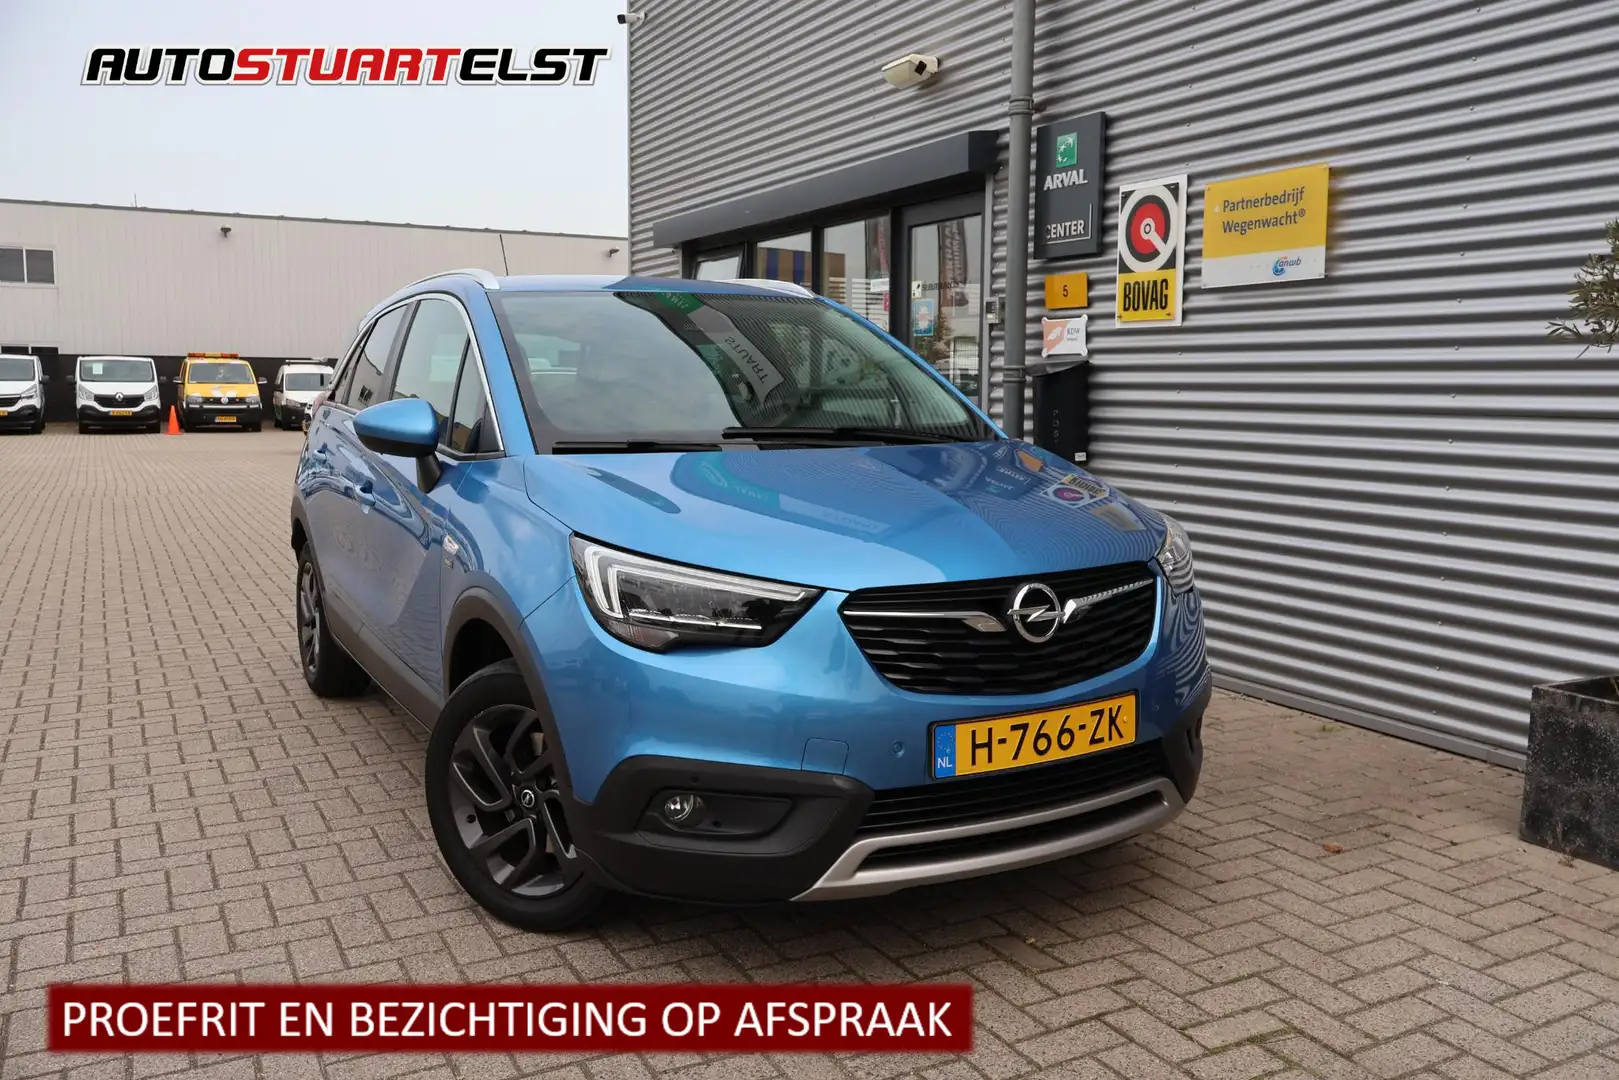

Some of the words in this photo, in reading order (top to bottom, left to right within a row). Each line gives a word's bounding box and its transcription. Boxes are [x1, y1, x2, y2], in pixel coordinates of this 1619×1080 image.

[1043, 168, 1089, 191] ARVAL
[1223, 186, 1305, 213] Partnerbedrijf
[1278, 256, 1302, 267] anwb
[1062, 284, 1069, 298] 5
[1122, 278, 1169, 312] BOVAG
[970, 704, 1125, 767] H-766-ZK
[937, 757, 953, 769] NL
